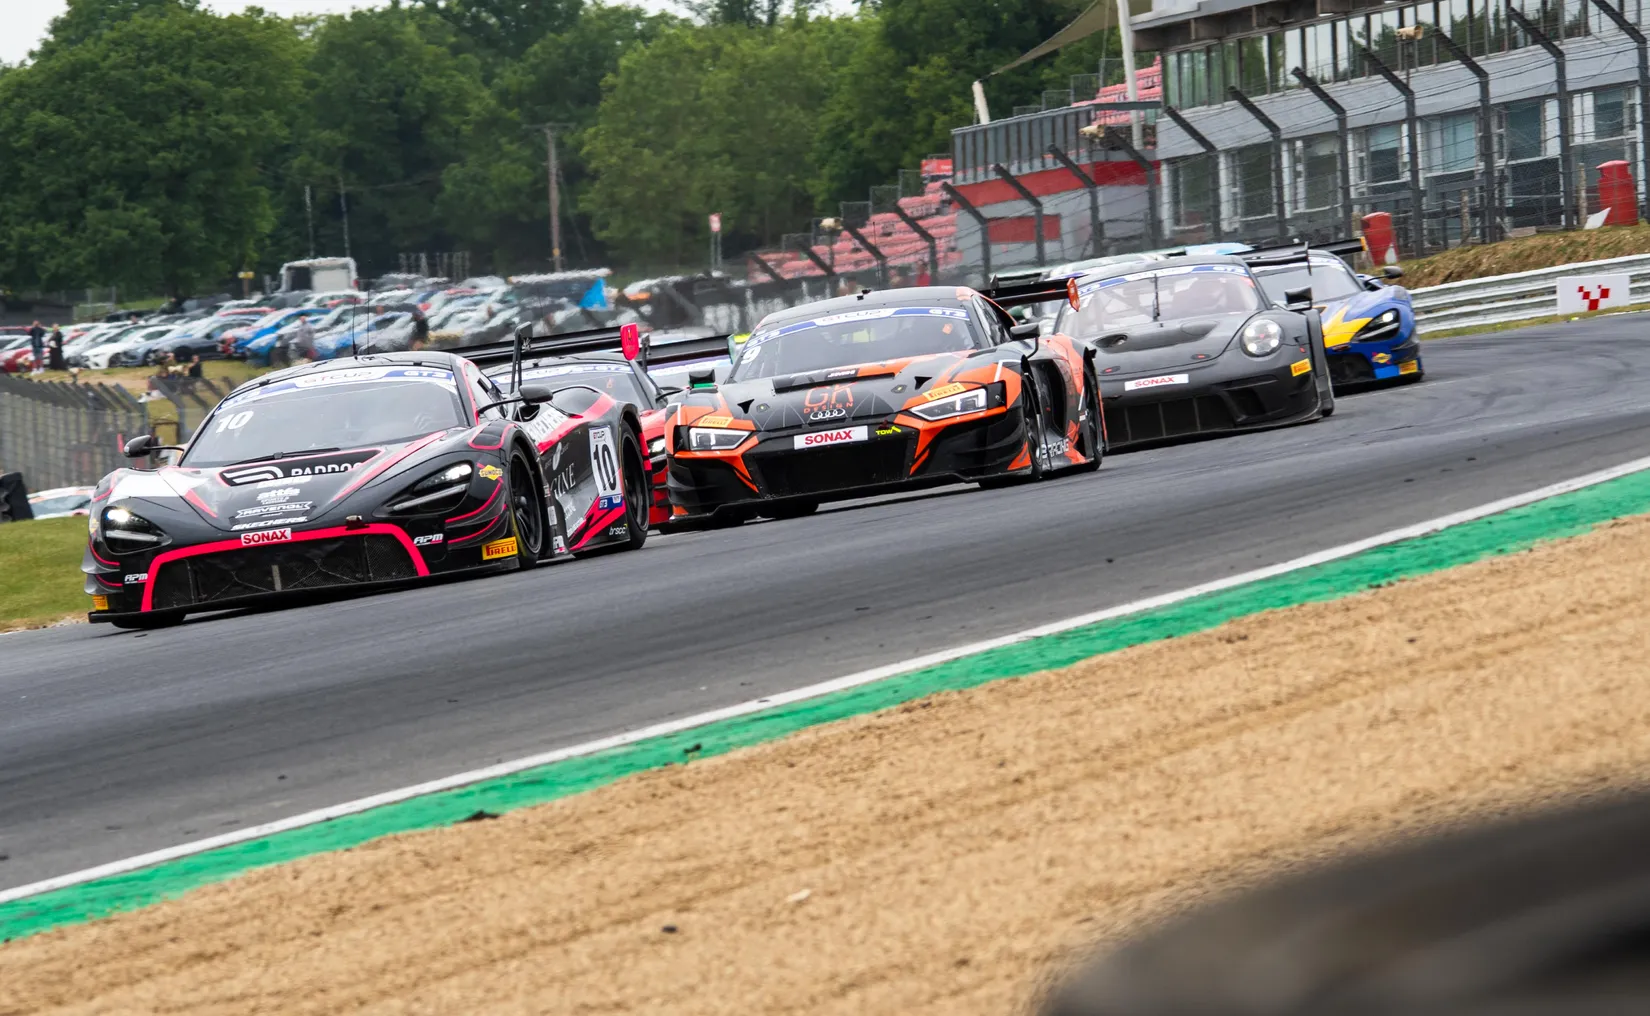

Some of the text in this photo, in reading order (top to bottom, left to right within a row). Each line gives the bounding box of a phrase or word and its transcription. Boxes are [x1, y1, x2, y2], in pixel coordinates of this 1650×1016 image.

[929, 309, 967, 317] GT3
[1134, 375, 1175, 388] SONAX
[216, 410, 254, 433] 10
[804, 430, 853, 445] SONAX
[593, 443, 617, 491] 10
[243, 530, 289, 545] SONAX
